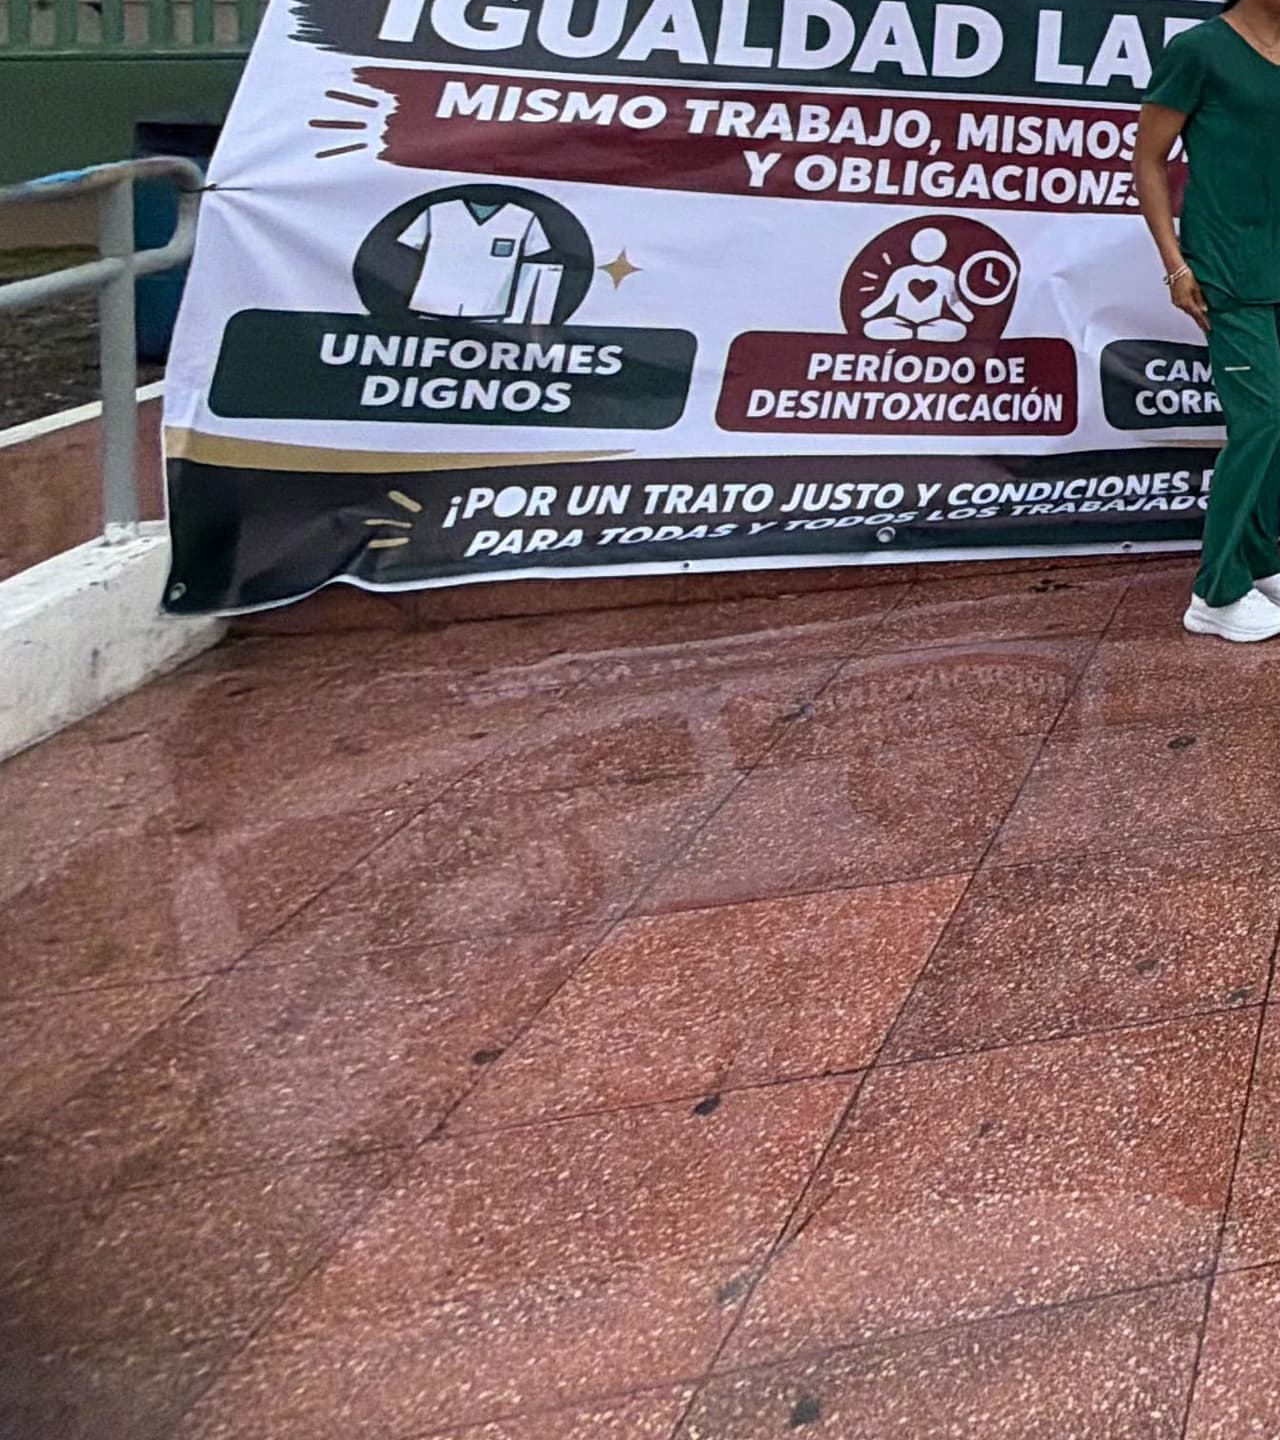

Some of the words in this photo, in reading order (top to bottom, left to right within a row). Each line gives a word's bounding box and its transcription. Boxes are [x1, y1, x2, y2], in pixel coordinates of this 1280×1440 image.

[435, 80, 668, 130] MISMO
[685, 99, 942, 156] TRABAJO,
[957, 112, 1140, 162] MISMOS
[742, 150, 782, 188] Y
[319, 333, 624, 377] UNIFORMES
[806, 348, 977, 385] PERÍODO
[984, 356, 1027, 385] DE
[360, 375, 573, 414] DIGNOS
[746, 386, 1064, 423] DESINTOXICACIÓN
[442, 484, 558, 529] ¡POR
[566, 484, 631, 516] UN
[643, 482, 775, 515] TRATO
[779, 482, 905, 513] JUSTO
[916, 482, 942, 508] Y
[946, 470, 1191, 507] CONDICIONES
[463, 527, 586, 558] PARA
[595, 522, 739, 546] TODAS
[745, 520, 779, 536] Y
[783, 510, 920, 532] TODOS
[924, 505, 1001, 522] LOS
